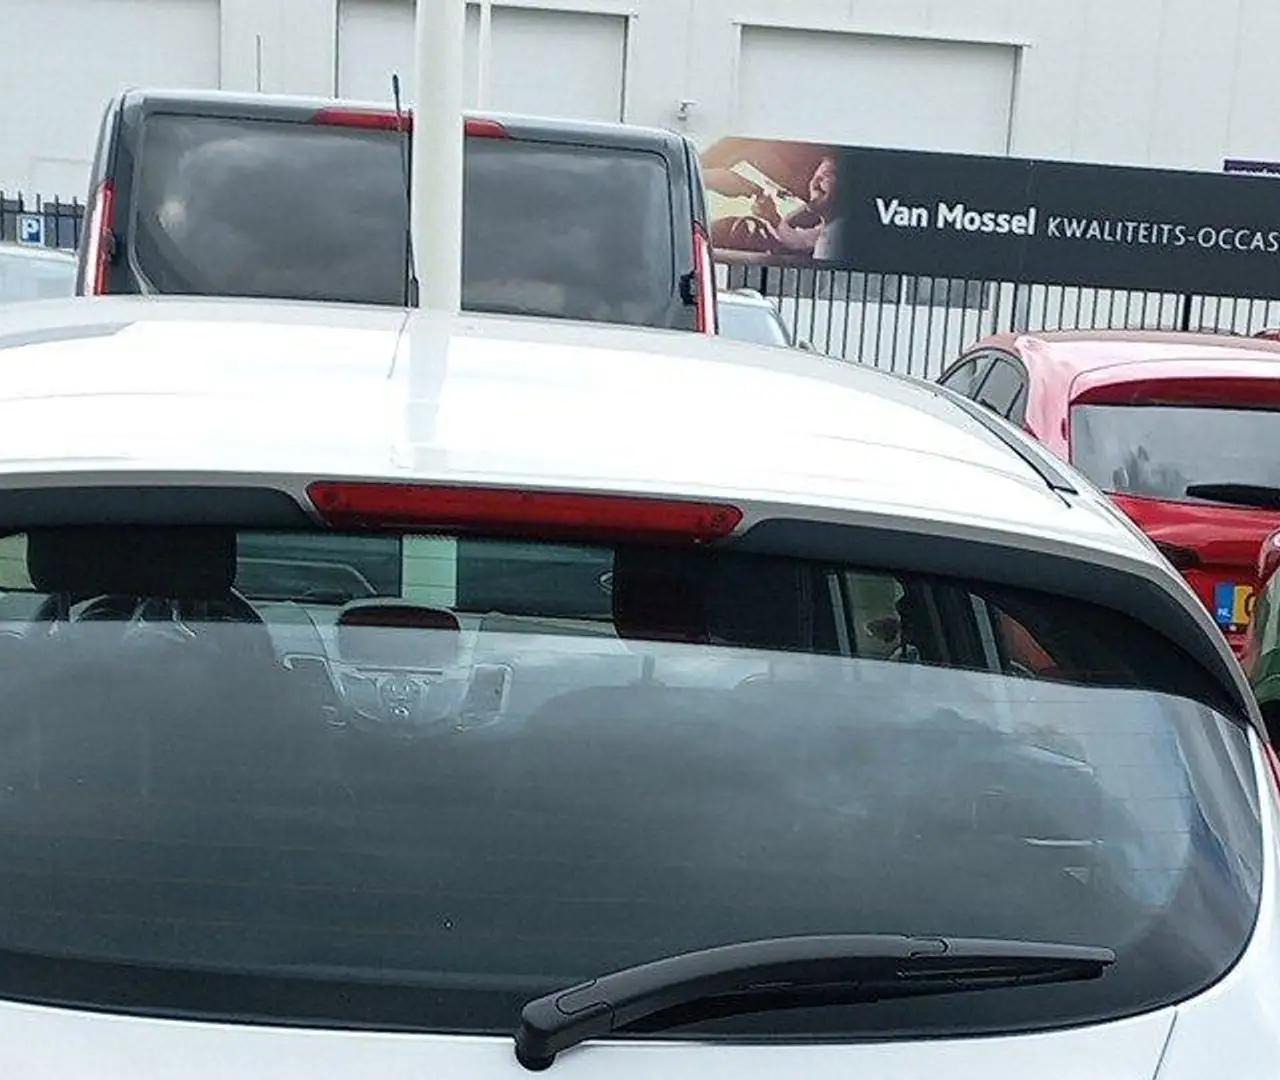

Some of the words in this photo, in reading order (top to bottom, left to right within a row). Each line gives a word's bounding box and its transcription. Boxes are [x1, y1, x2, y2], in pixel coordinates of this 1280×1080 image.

[22, 217, 39, 239] P
[875, 198, 929, 228] Van
[936, 202, 1037, 236] Mossel
